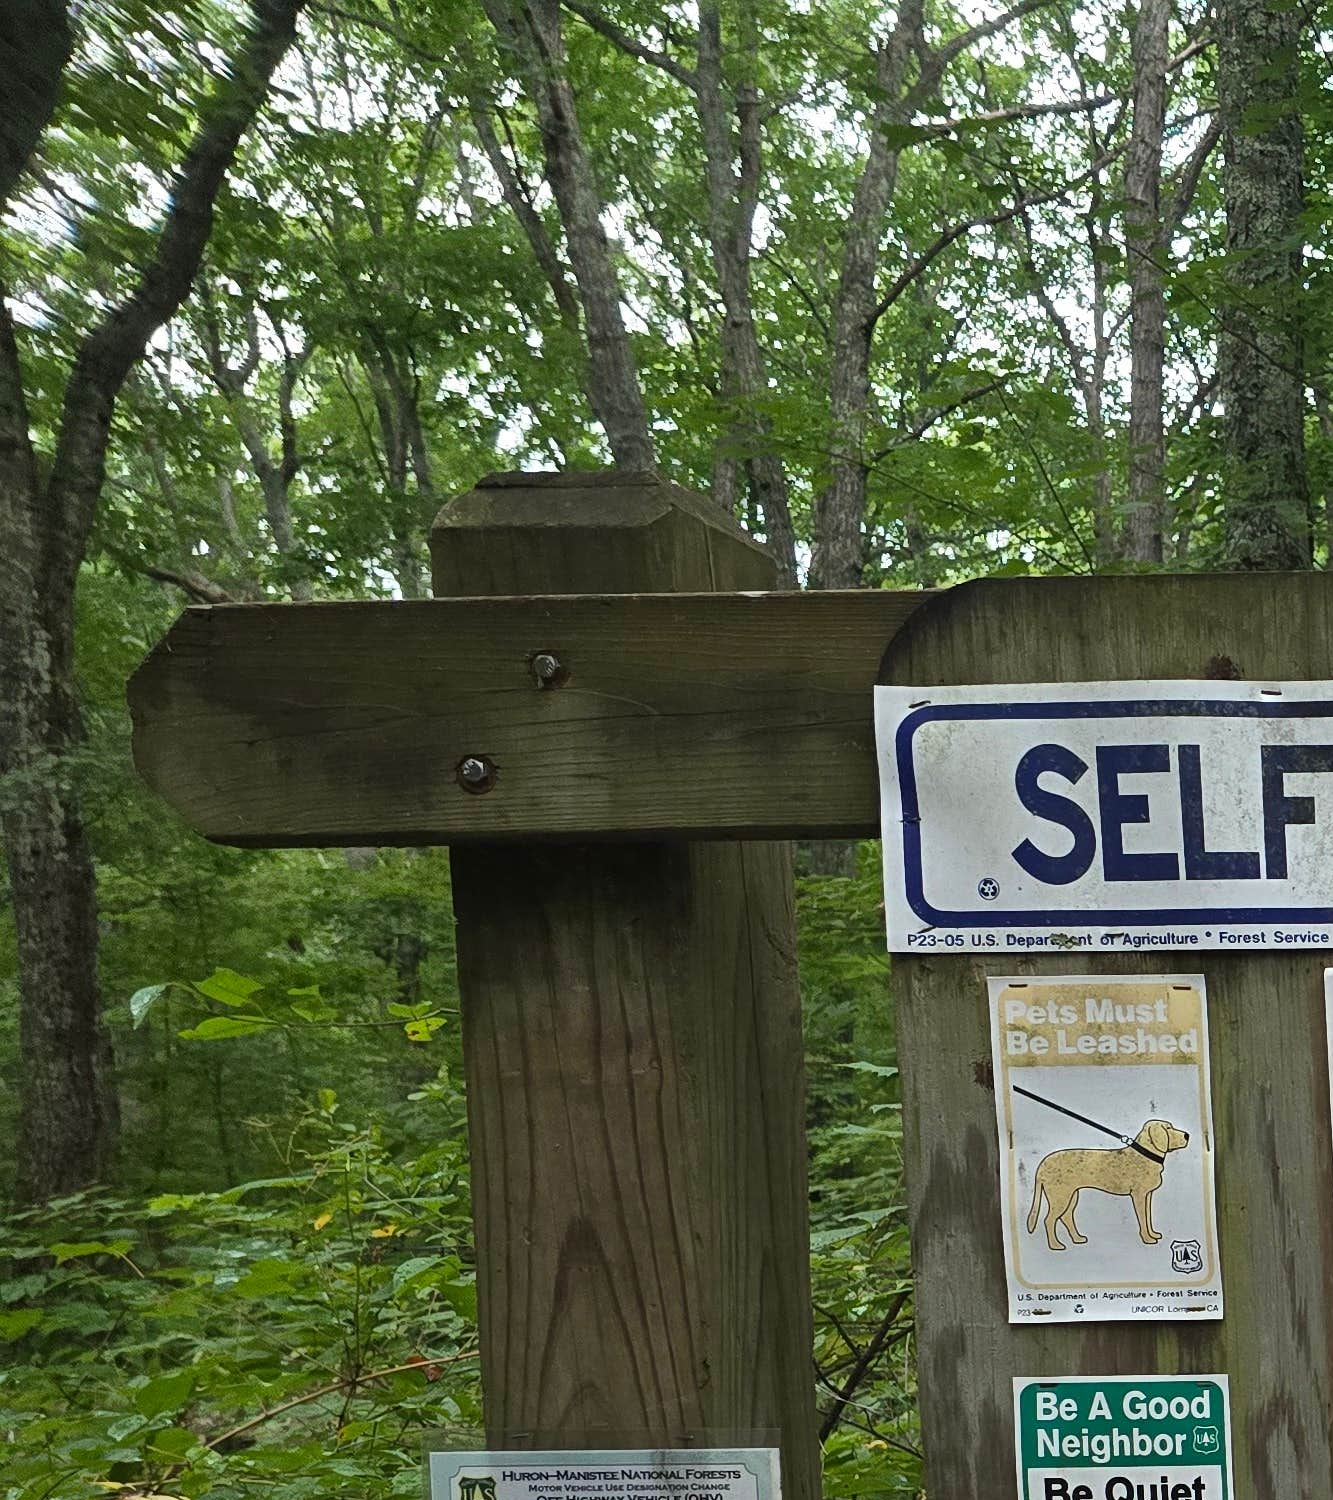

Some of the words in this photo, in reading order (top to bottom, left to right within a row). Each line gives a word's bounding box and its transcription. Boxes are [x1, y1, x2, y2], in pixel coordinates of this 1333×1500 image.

[908, 934, 964, 946] P23-05
[972, 934, 999, 946] U.S.
[1006, 933, 1092, 947] Deparnt
[1122, 932, 1198, 946] Agriculture
[1219, 932, 1265, 944] Forest
[1273, 931, 1329, 943] Service
[1006, 1000, 1077, 1025] Pets
[1086, 999, 1168, 1024] Must
[1006, 1031, 1049, 1055] Be
[1058, 1028, 1198, 1055] Leashed
[1038, 1293, 1086, 1302] Department
[1103, 1292, 1146, 1300] Agriculture
[1036, 1392, 1077, 1420] Be
[1088, 1391, 1112, 1420] A
[1123, 1389, 1210, 1420] Good
[1037, 1427, 1186, 1463] Neighbor
[621, 1470, 684, 1480] NATIONAL
[686, 1469, 741, 1479] FORESTS
